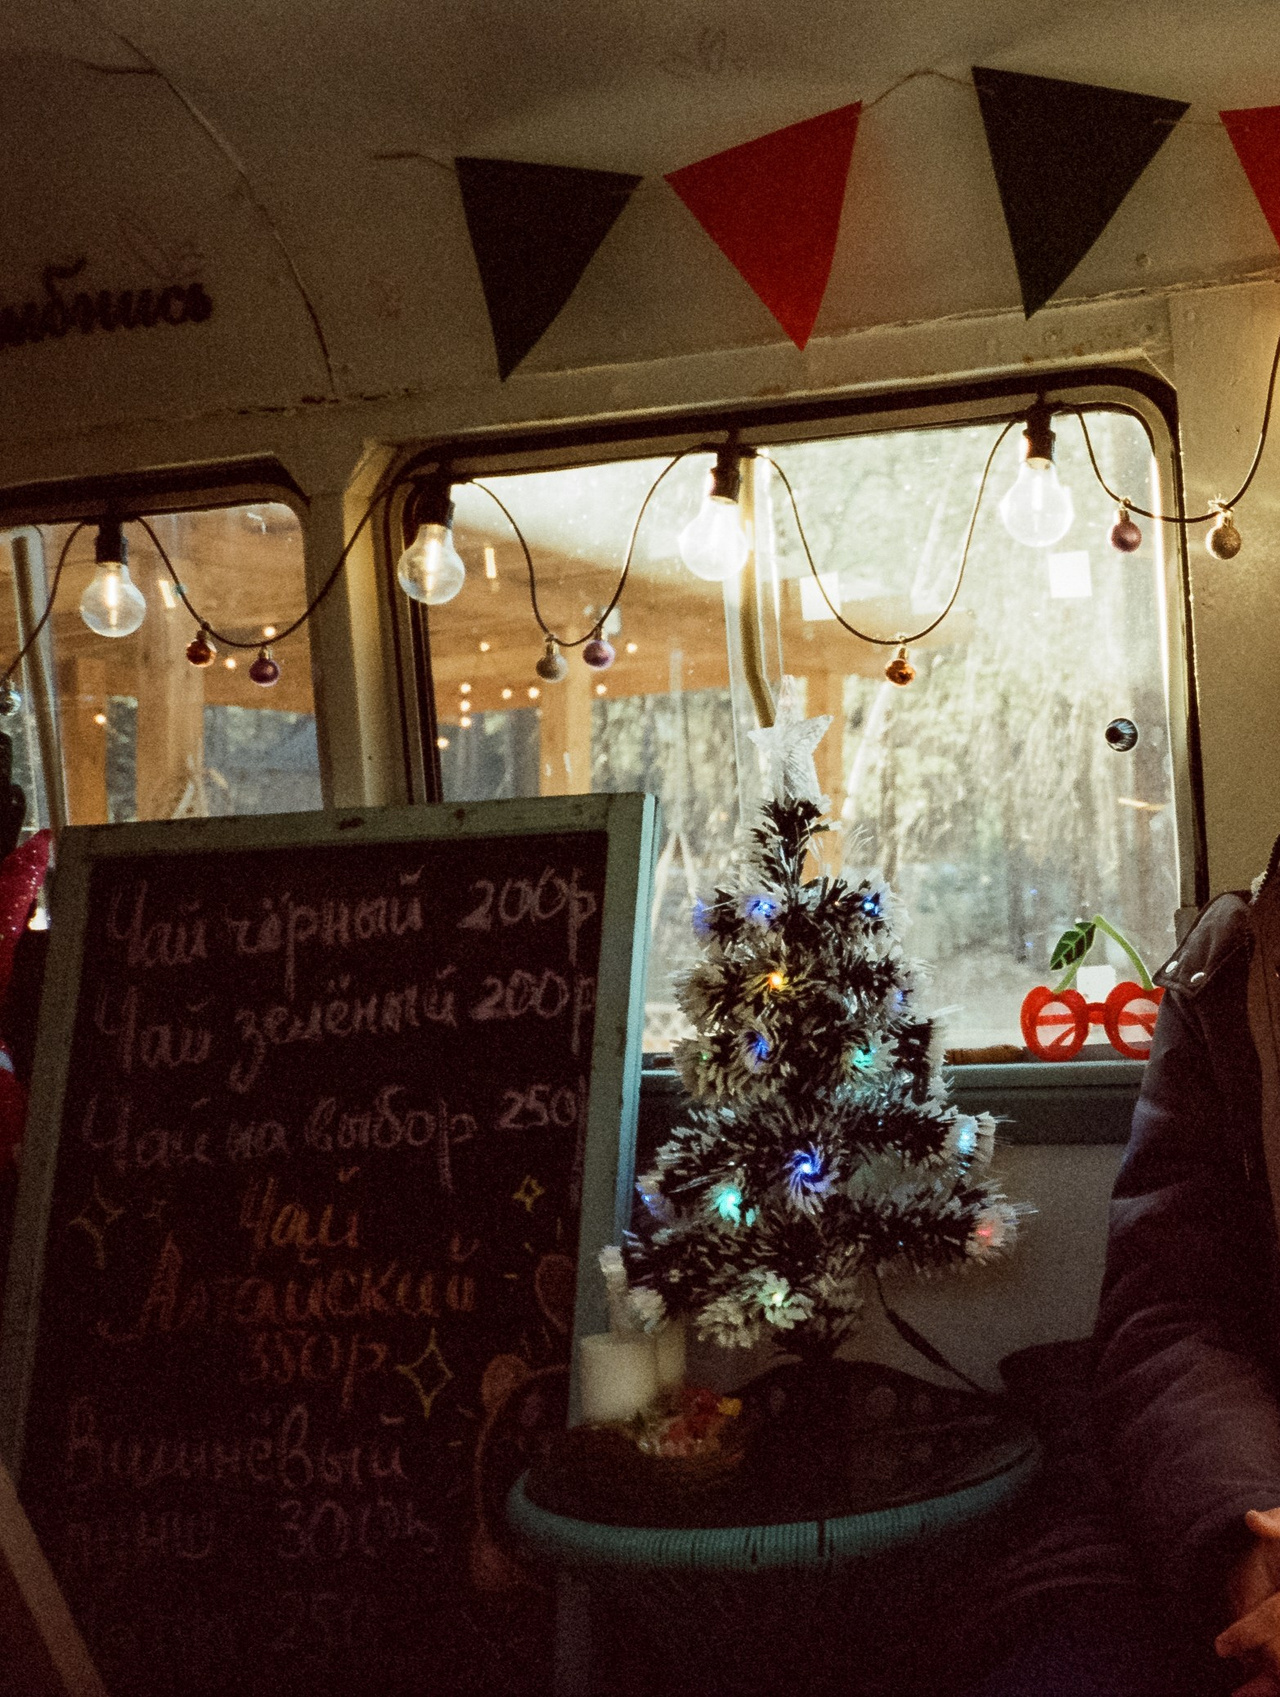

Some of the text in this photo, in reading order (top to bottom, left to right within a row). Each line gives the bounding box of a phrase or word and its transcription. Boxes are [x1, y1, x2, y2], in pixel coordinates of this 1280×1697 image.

[105, 879, 209, 969] Чай
[94, 982, 212, 1074] Чай
[229, 965, 458, 1094] зелёный
[83, 1093, 212, 1172] Чай
[239, 1167, 361, 1252] Чай
